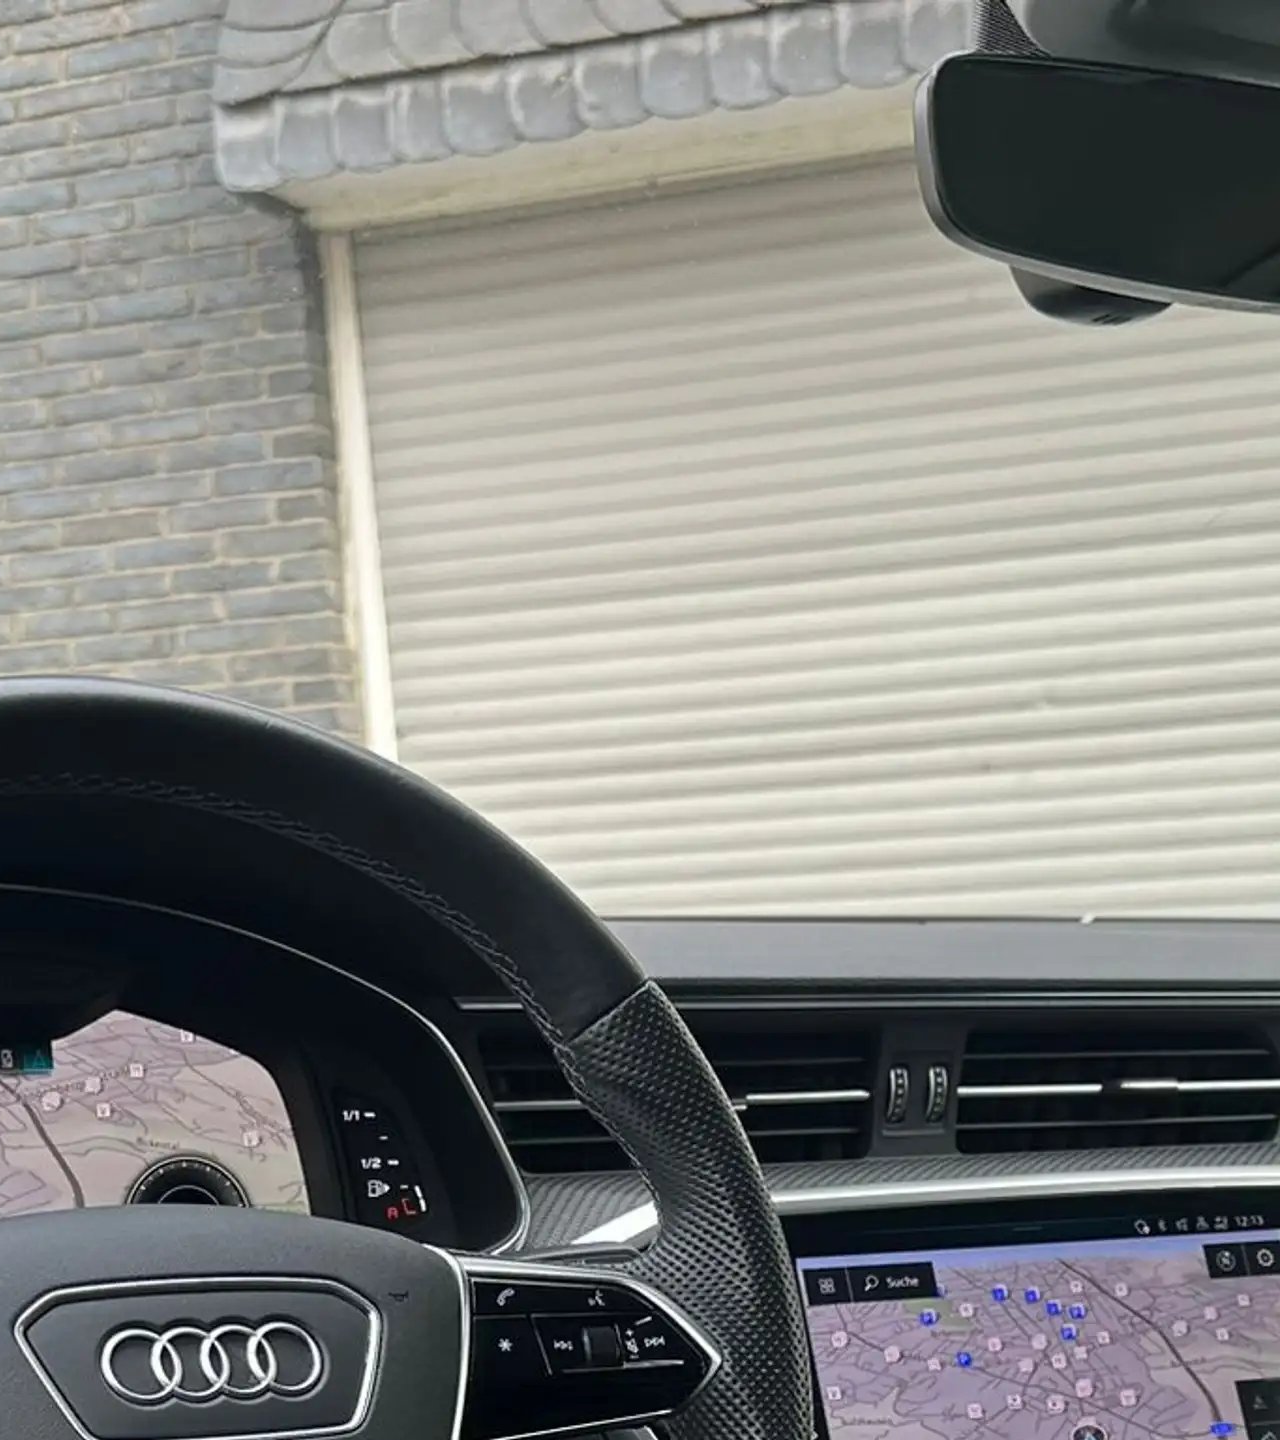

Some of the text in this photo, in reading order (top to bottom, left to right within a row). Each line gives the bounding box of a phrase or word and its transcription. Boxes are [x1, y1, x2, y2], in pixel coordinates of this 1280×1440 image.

[343, 1110, 360, 1121] 1/1
[361, 1157, 381, 1169] 1/2
[887, 1276, 920, 1288] Suche
